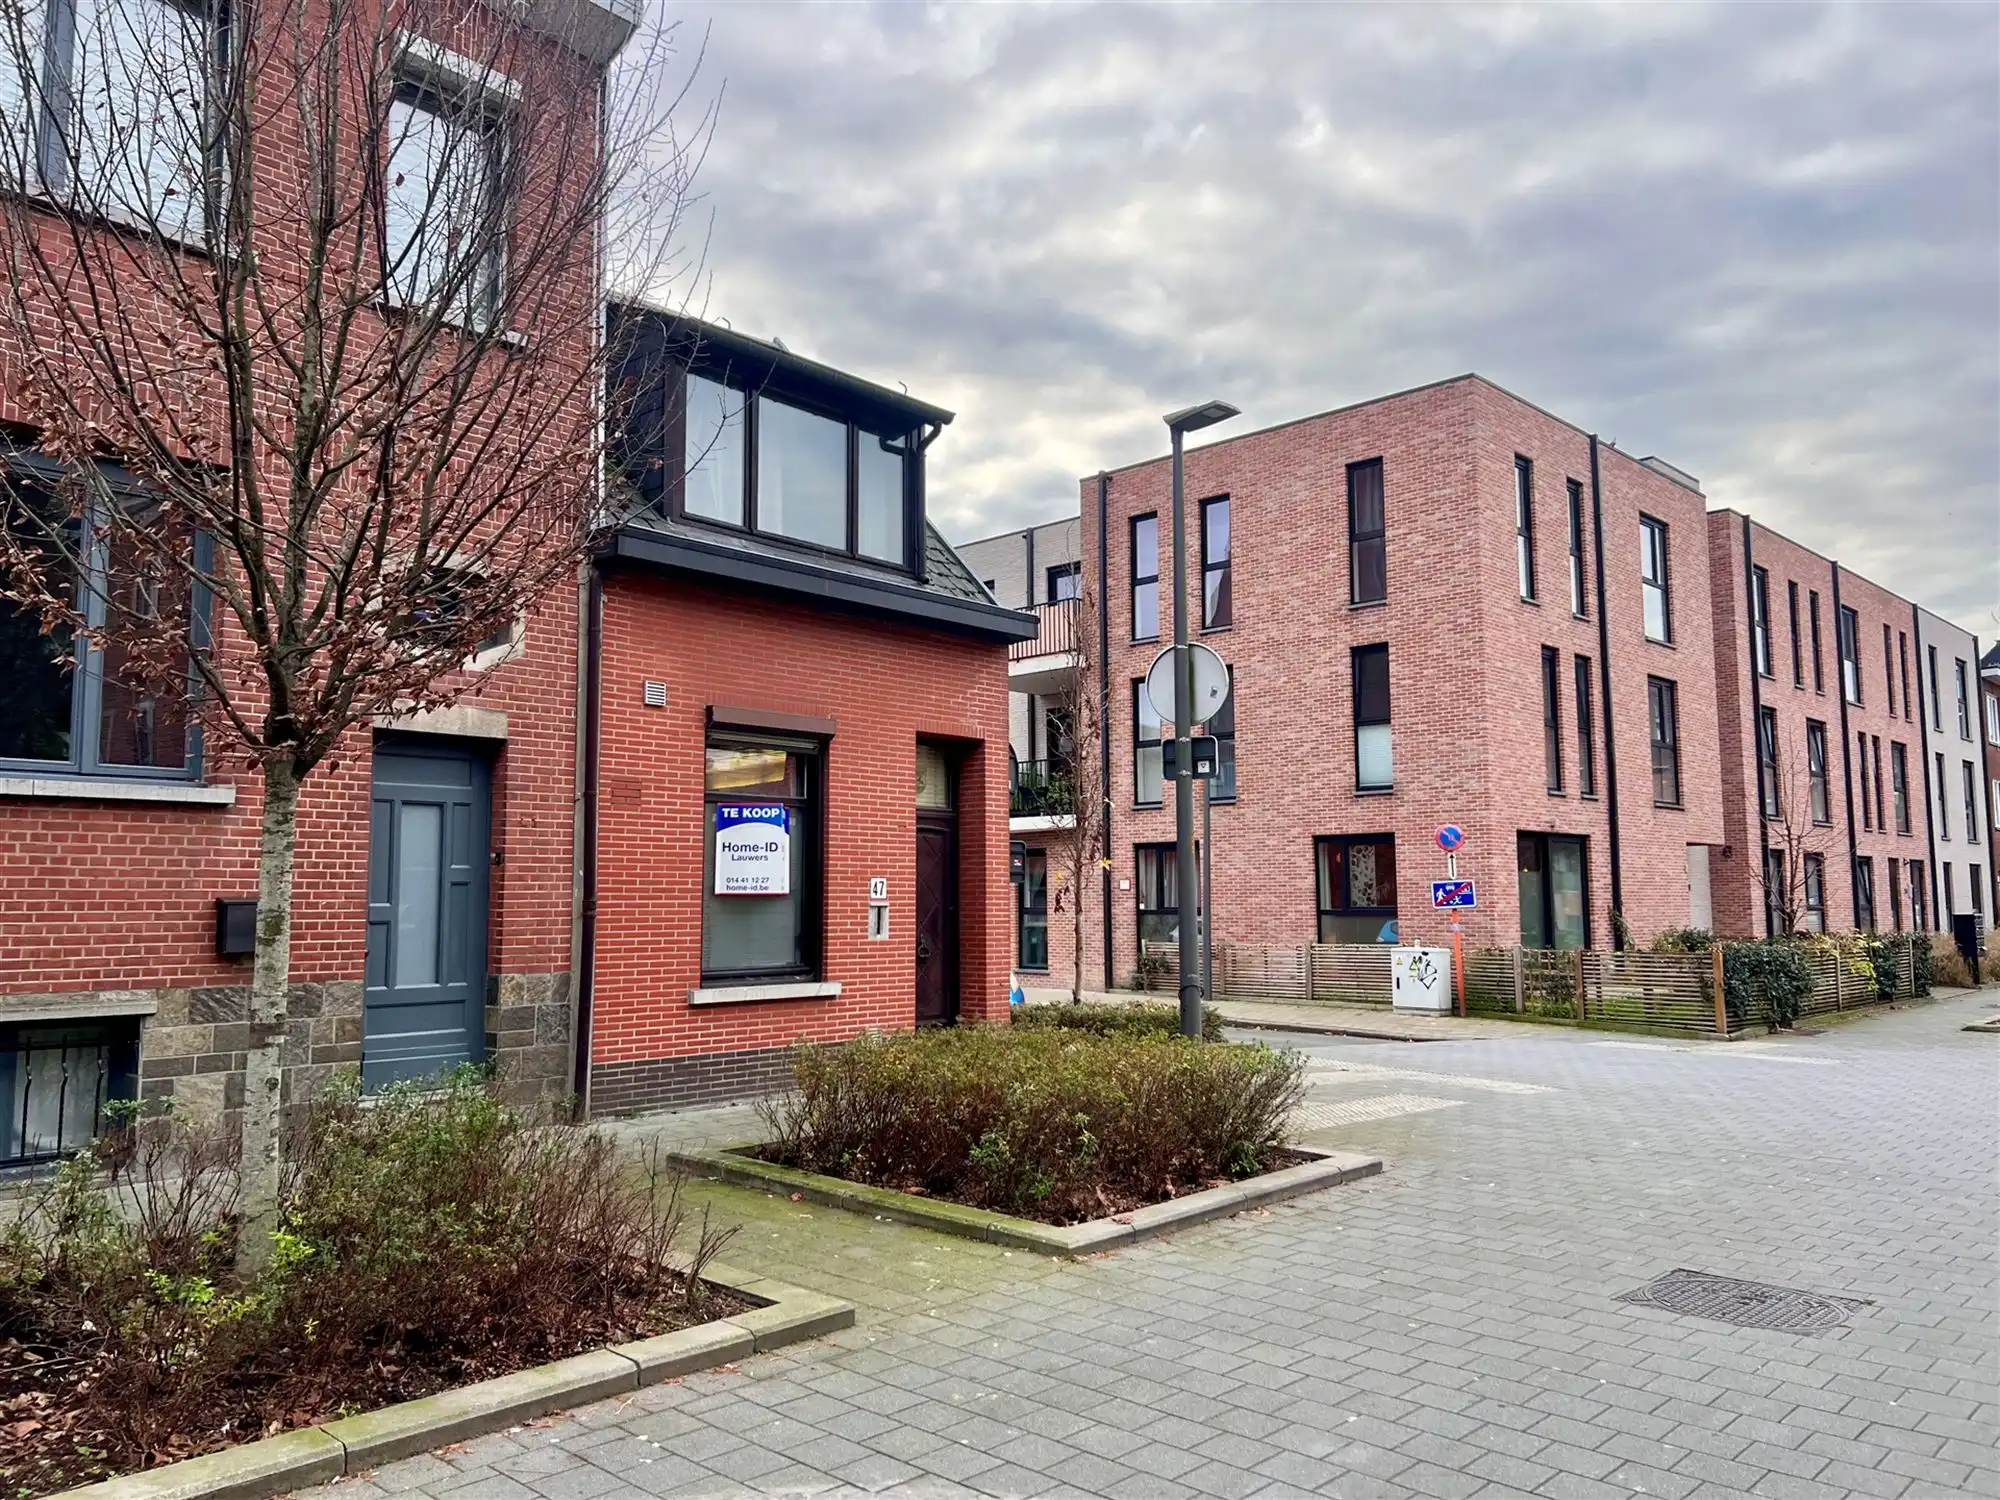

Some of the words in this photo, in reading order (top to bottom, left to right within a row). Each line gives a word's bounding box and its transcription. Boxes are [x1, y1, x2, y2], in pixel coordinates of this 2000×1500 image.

[722, 808, 739, 818] TE
[742, 808, 780, 818] KOOP
[722, 842, 778, 852] Home-ID
[873, 881, 885, 896] 47
